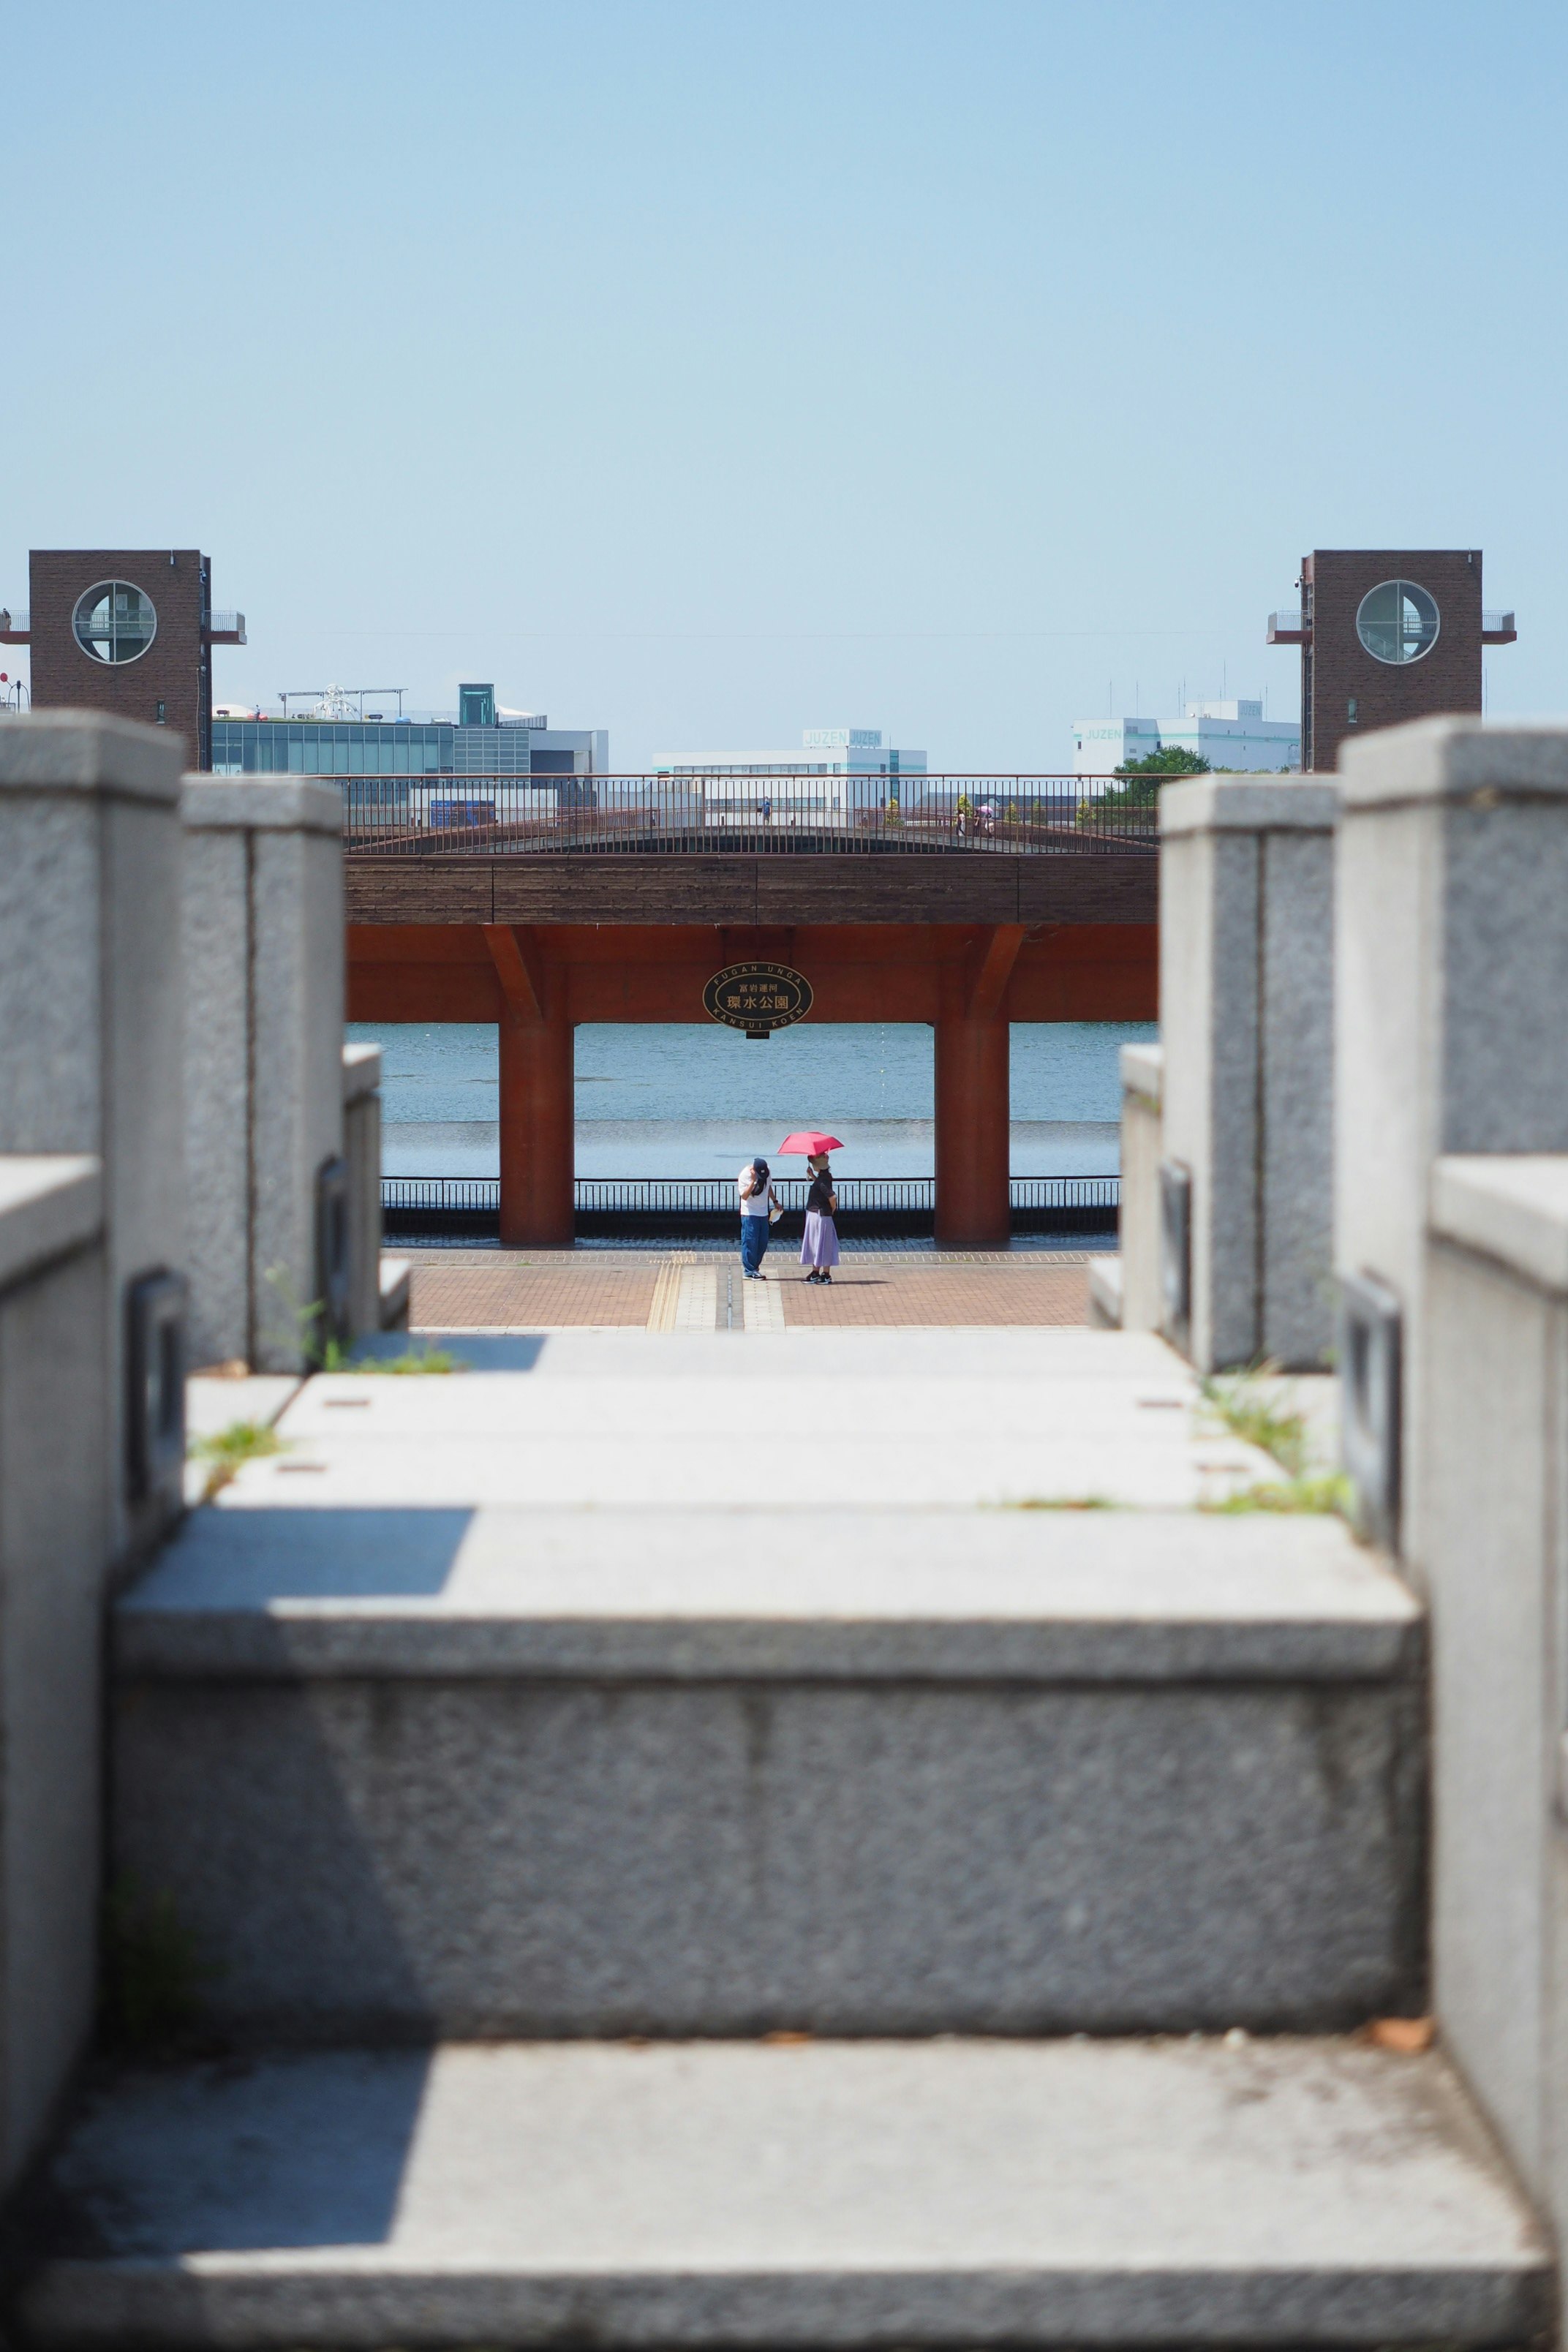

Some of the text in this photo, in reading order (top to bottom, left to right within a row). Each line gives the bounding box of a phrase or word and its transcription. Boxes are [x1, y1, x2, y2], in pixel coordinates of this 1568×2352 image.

[804, 731, 846, 745] JUZEN
[850, 731, 880, 745] JUZEN
[1086, 728, 1122, 739] JUZEN
[714, 965, 802, 985] FUGAN UNGA
[739, 983, 778, 993] 富岩運河
[726, 995, 789, 1010] 環水公園
[712, 1008, 804, 1029] KANSUI KOEN
